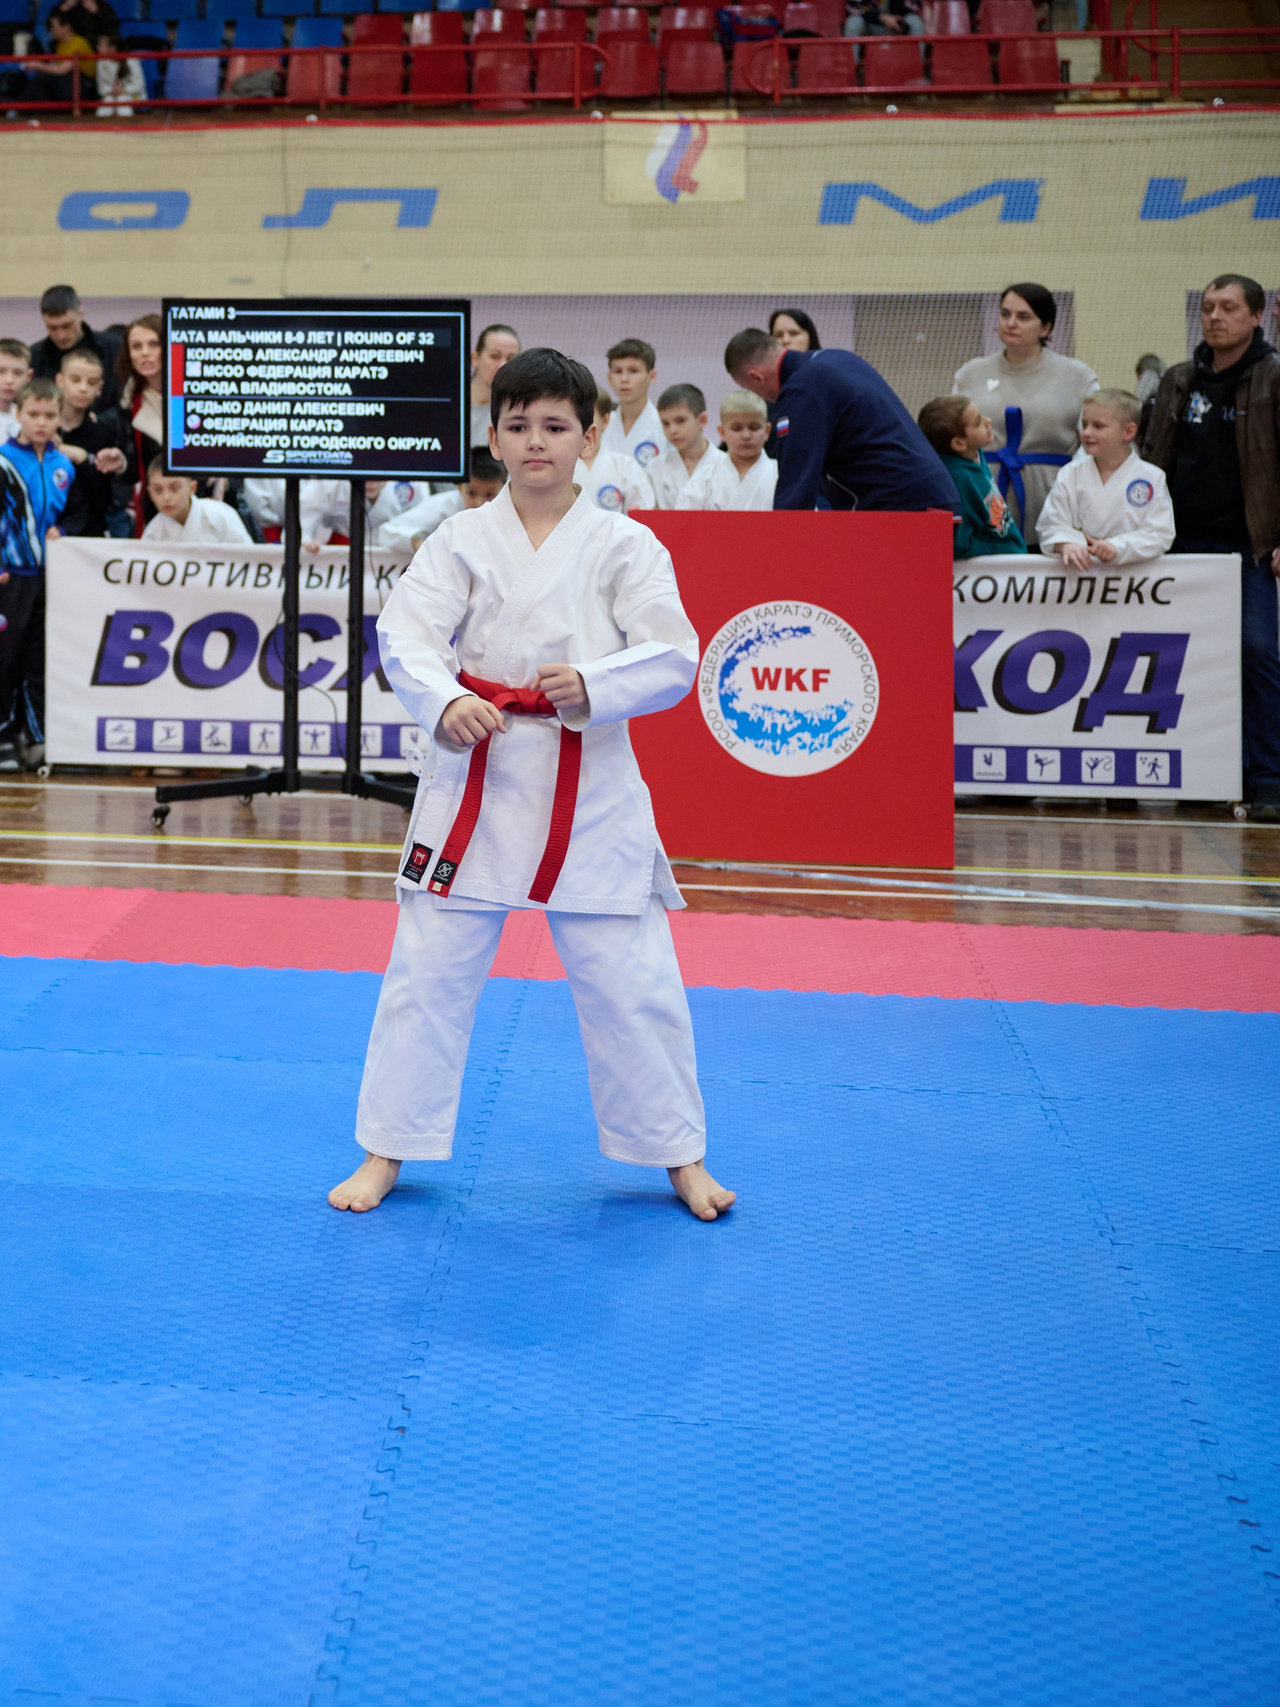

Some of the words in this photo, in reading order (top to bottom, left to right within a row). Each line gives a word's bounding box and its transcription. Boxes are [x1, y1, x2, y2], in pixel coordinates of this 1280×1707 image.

[171, 306, 226, 320] ТАТАМИ
[227, 306, 236, 320] 3
[171, 330, 206, 344] КАТА
[207, 330, 283, 344] МАЛЬЧИКИ
[284, 331, 306, 344] 8-9
[306, 331, 336, 345] ЛЕТ
[343, 331, 394, 345] ROUND
[395, 332, 416, 345] OF
[418, 332, 435, 346] 32
[186, 348, 254, 362] КОЛОСОВ
[255, 348, 338, 364] АЛЕКСАНДР
[339, 349, 425, 364] АНДРЕЕВИЧ
[203, 364, 245, 378] МСОО
[246, 365, 333, 380] ФЕДЕРАЦИЯ
[334, 365, 389, 379] КАРАТЭ
[183, 381, 239, 396] ГОРОДА
[240, 381, 353, 397] ВЛАДИВОСТОКА
[186, 400, 242, 415] РЕДЬКО
[242, 401, 291, 416] ДАНИЛ
[292, 402, 386, 417] АЛЕКСЕЕВИЧ
[202, 417, 288, 433] ФЕДЕРАЦИЯ
[289, 418, 344, 433] КАРАТЭ
[183, 432, 291, 448] УССУРИЙСКОГО
[292, 435, 386, 451] ГОРОДСКОГО
[387, 436, 442, 451] ОКРУГА
[103, 558, 352, 590] СПОРТИВЫ
[705, 707, 738, 751] РСОО
[753, 603, 813, 621] КАРАТЭ
[815, 611, 877, 716] ПРИМОРСКОГО
[750, 666, 831, 693] WKF
